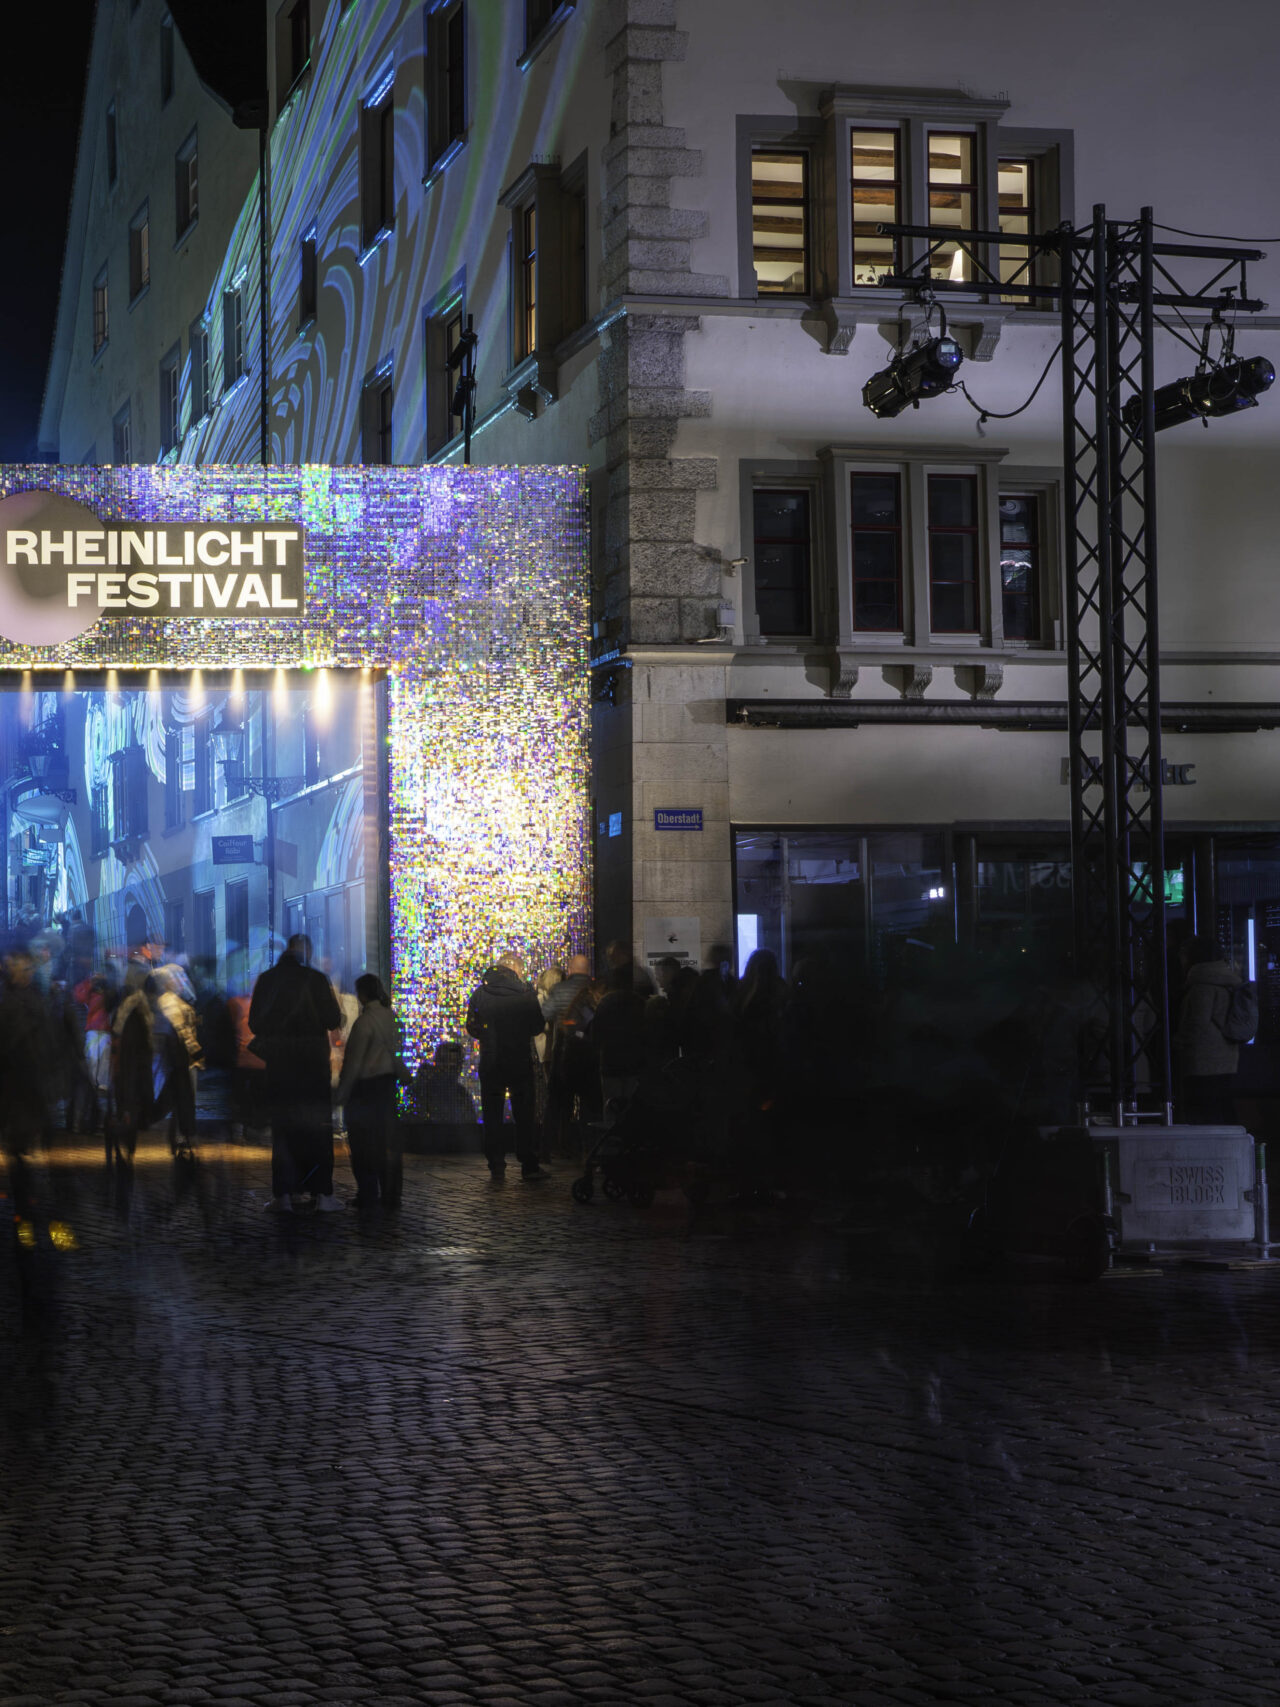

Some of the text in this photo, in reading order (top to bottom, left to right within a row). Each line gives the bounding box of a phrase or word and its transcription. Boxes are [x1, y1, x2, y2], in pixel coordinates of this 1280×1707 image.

[6, 530, 298, 566] RHEINLICHT
[67, 573, 298, 608] FESTIVAL
[657, 812, 701, 824] Oberstadt
[1175, 1166, 1225, 1185] SWISS
[1174, 1186, 1225, 1204] BLOCK
